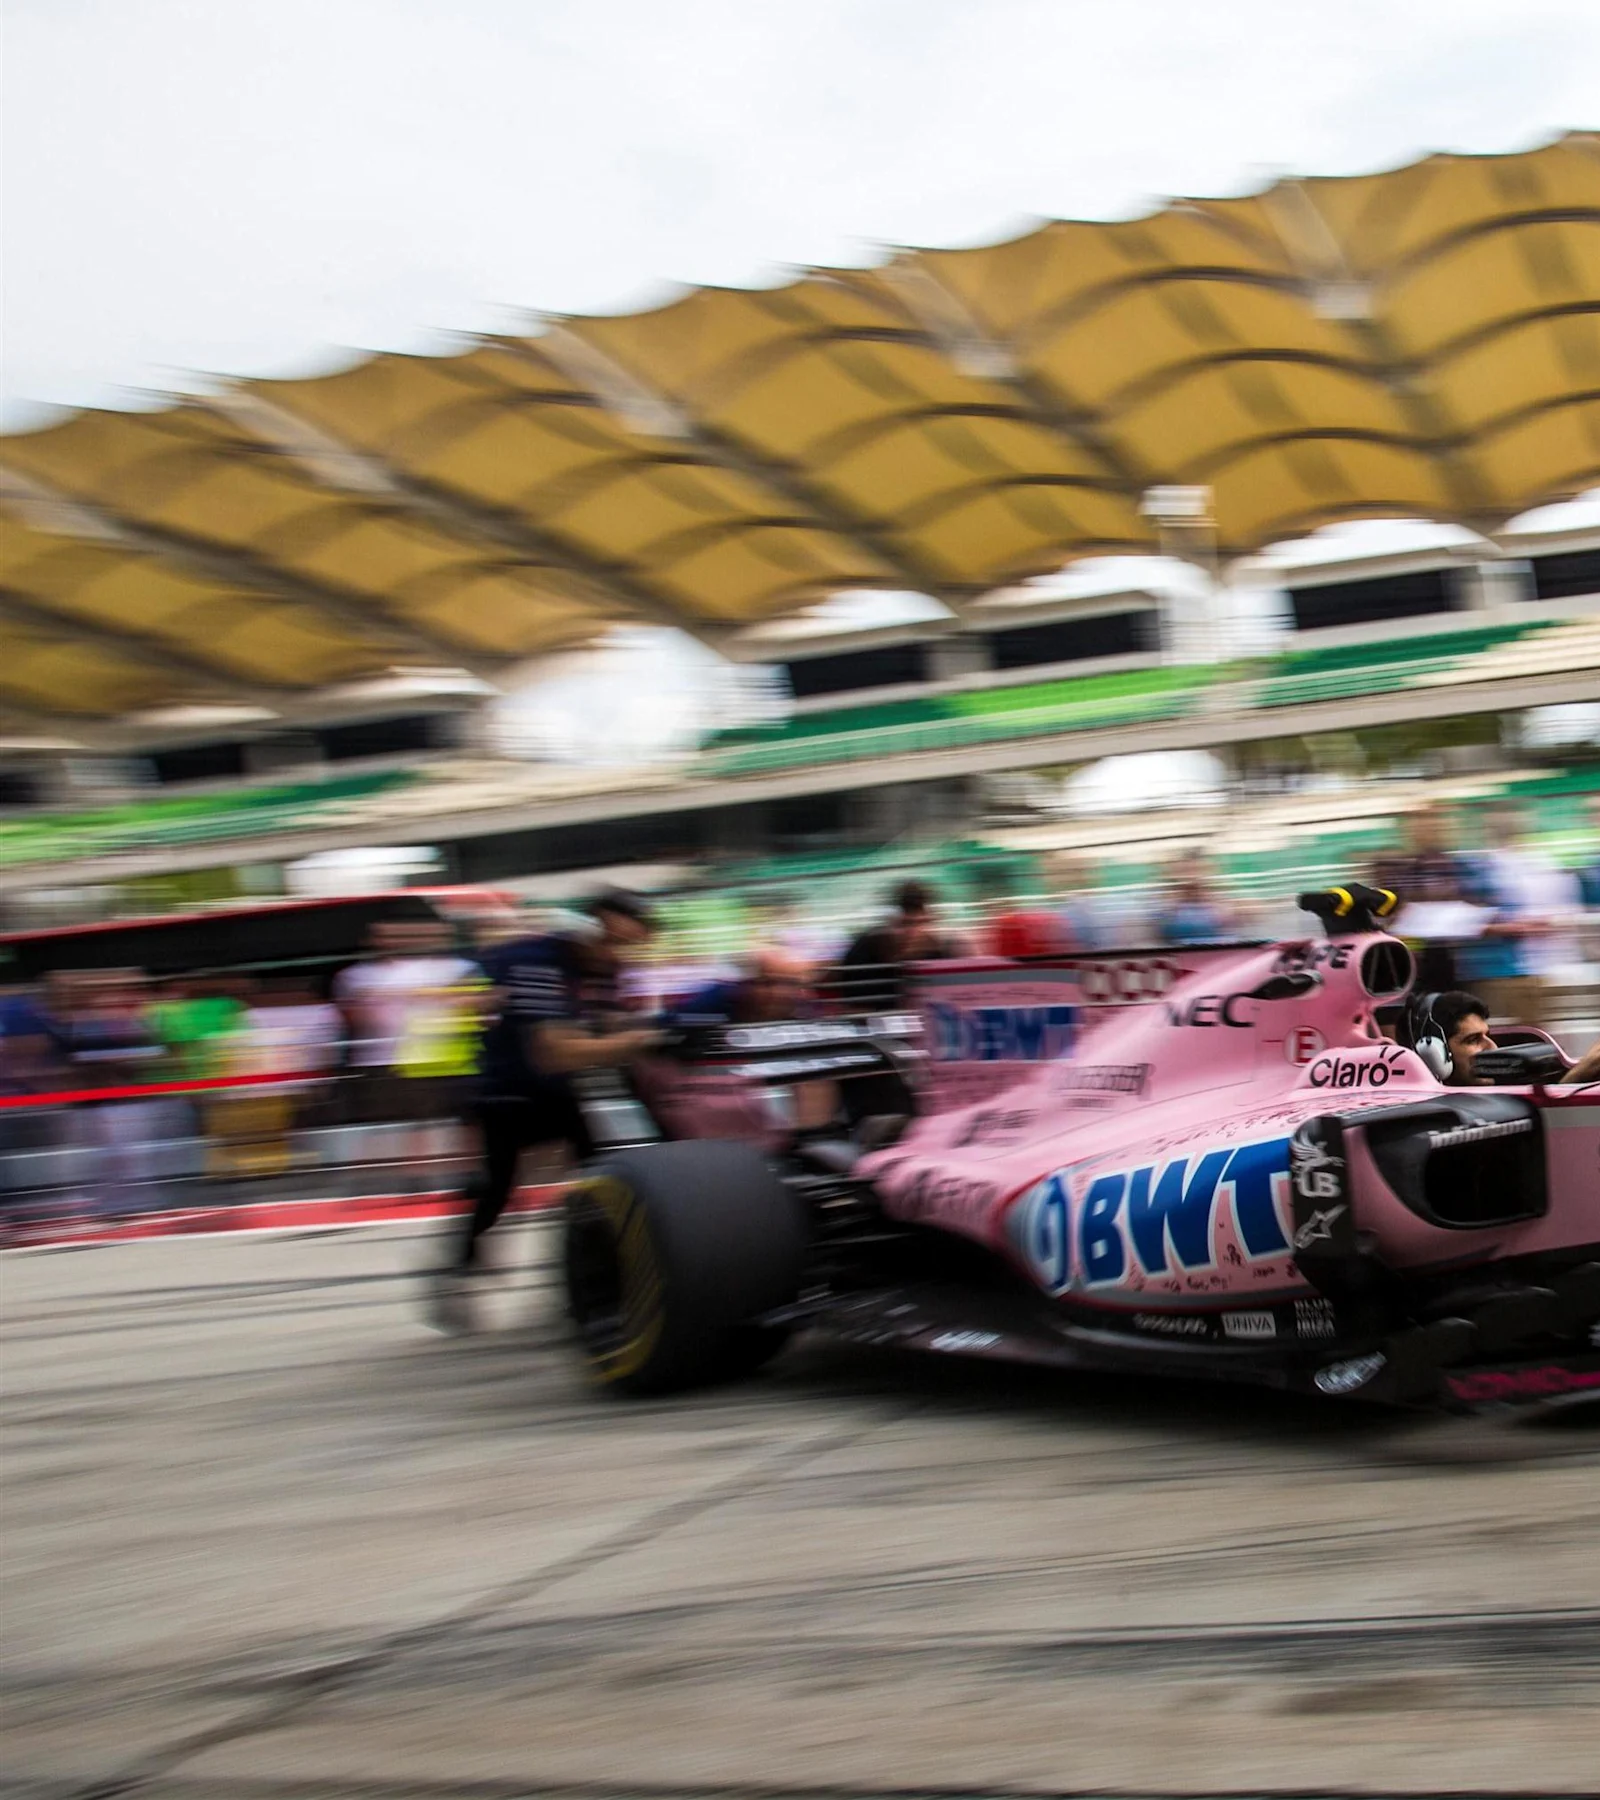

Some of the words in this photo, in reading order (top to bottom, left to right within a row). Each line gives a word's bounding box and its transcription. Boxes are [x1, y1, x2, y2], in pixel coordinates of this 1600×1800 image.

[1309, 1054, 1392, 1088] Claro
[1080, 1136, 1292, 1282] BWT
[1225, 1315, 1273, 1332] UNIVA
